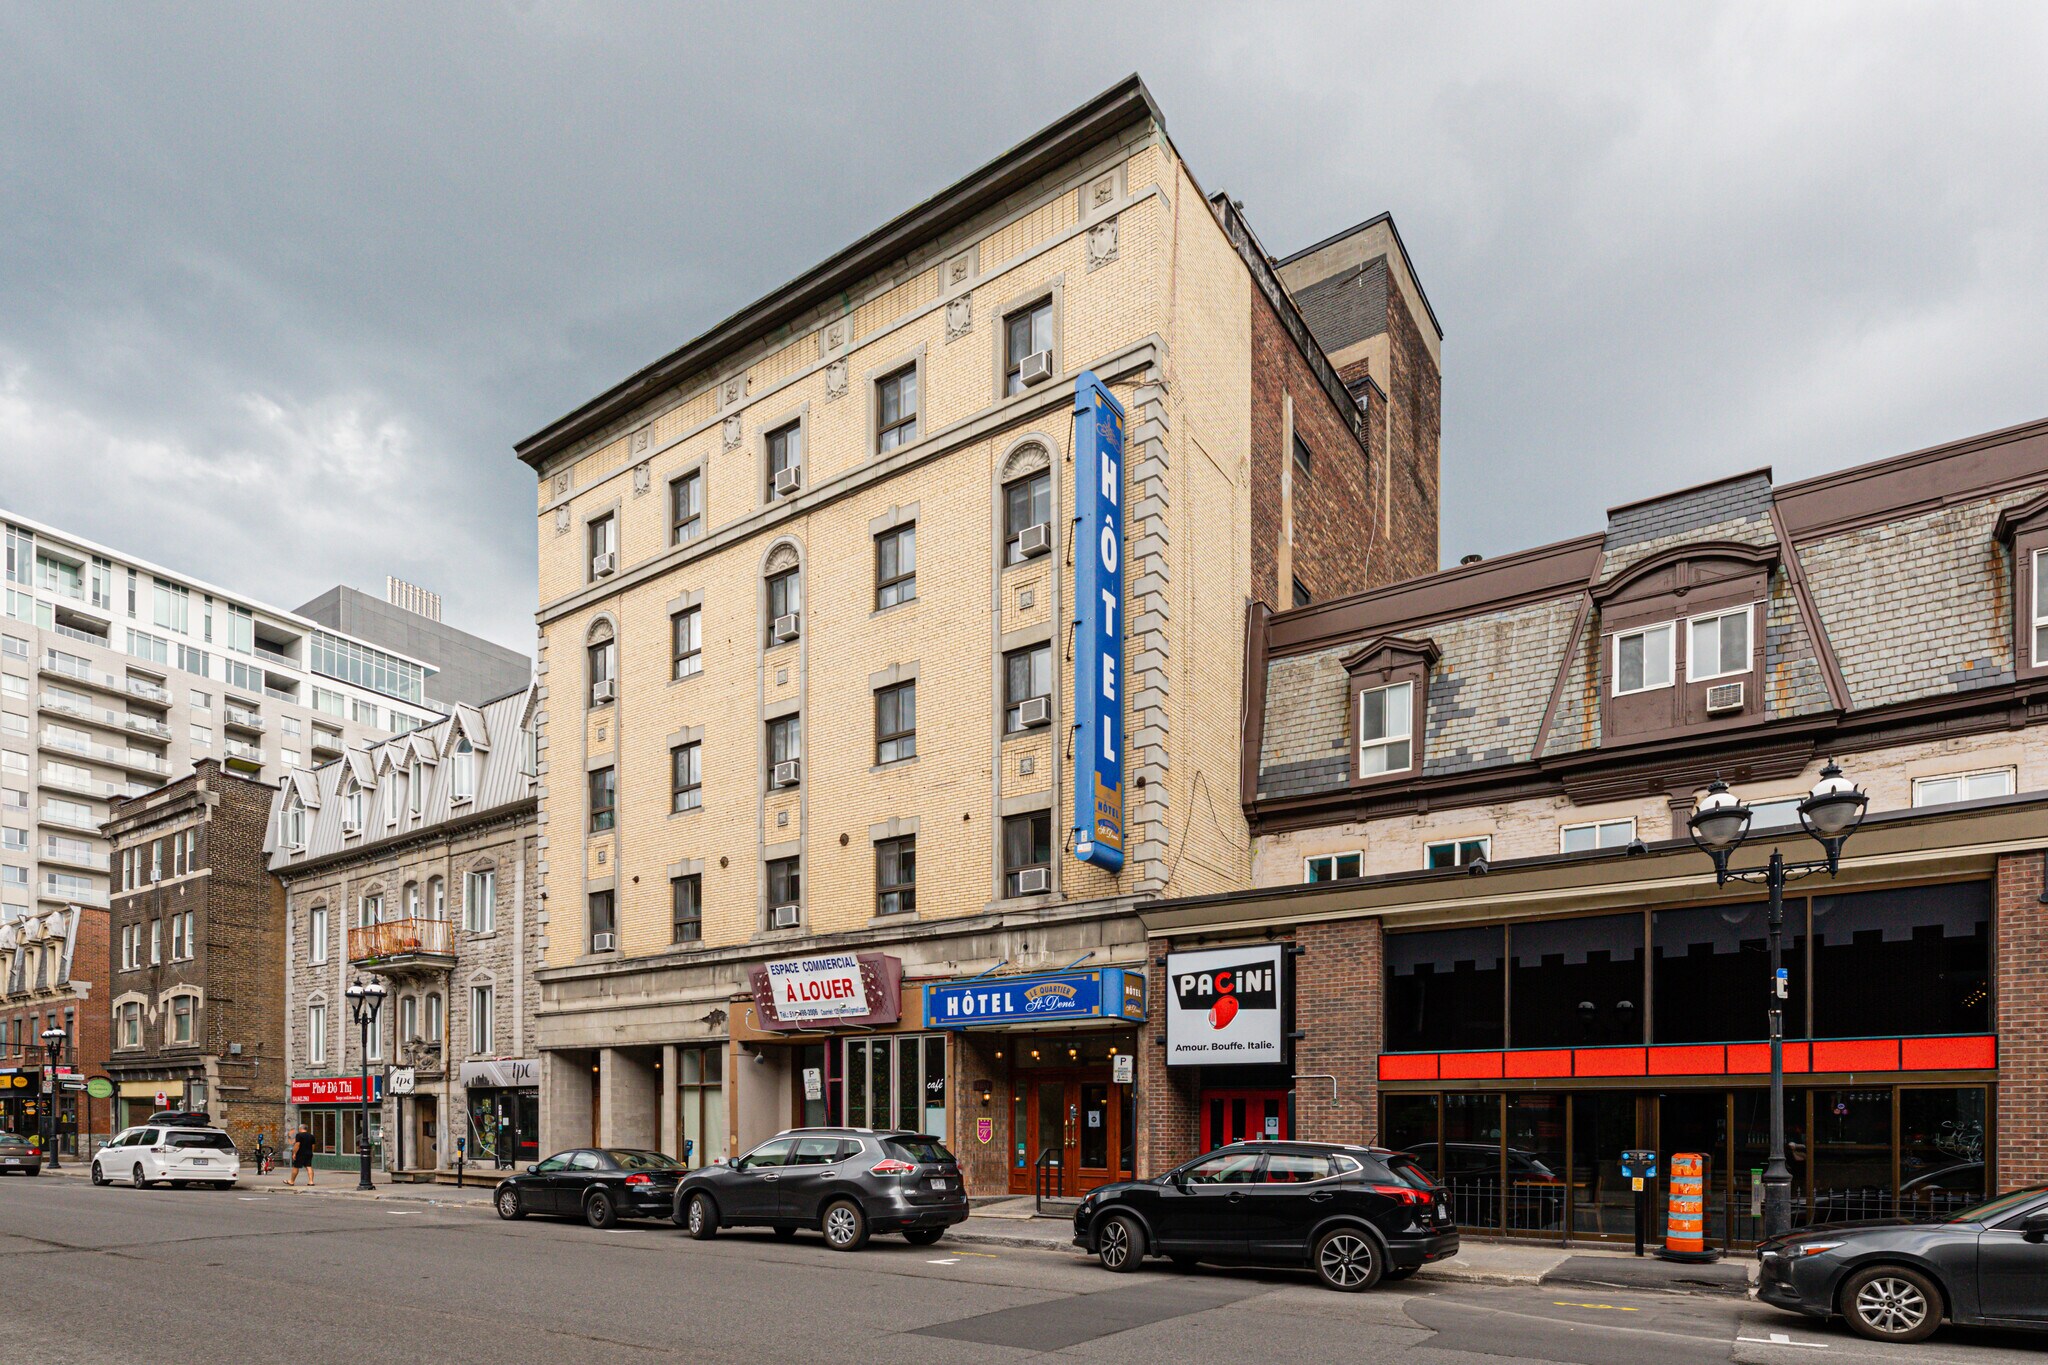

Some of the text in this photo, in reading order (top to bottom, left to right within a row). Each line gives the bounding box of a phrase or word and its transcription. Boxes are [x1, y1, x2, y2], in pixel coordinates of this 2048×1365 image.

[1101, 451, 1118, 763] HÔTEL
[770, 956, 856, 976] ESPACE COMMERCIAL
[787, 978, 855, 1003] À LOUER
[1029, 984, 1071, 998] LE QUARTIER
[947, 989, 1014, 1017] HÔTEL
[1175, 1040, 1275, 1052] Amour. Bouffe. Italie.
[1120, 1057, 1127, 1066] P
[808, 1070, 815, 1078] P
[927, 1078, 944, 1092] café
